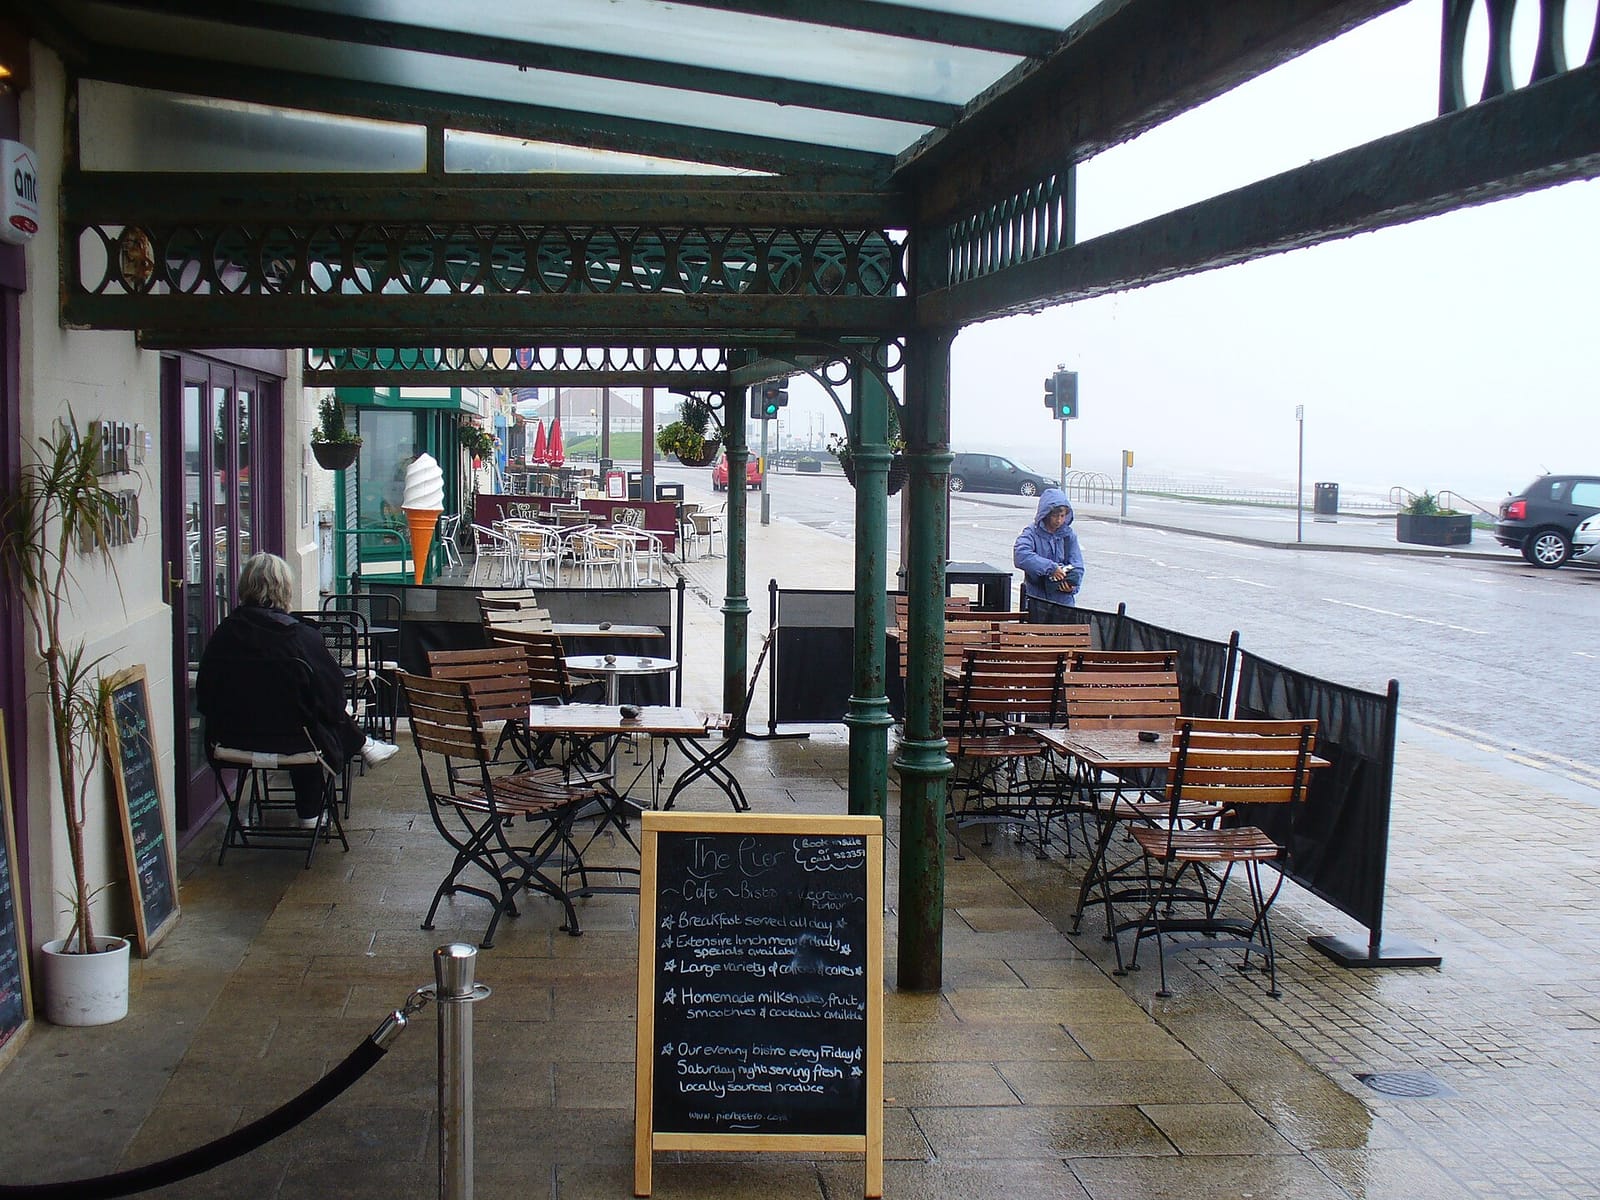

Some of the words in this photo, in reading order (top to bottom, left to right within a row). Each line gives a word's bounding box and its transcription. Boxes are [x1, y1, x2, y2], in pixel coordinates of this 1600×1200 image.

[685, 836, 730, 871] The
[801, 838, 828, 849] Book
[682, 879, 719, 905] Cafe
[678, 911, 743, 929] Breakfast
[744, 915, 787, 928] served
[789, 915, 808, 928] all
[808, 917, 833, 933] day
[676, 934, 733, 947] Extensive
[735, 934, 767, 946] lunch
[768, 936, 798, 947] menu
[693, 947, 745, 959] specials
[680, 959, 722, 978] Large
[723, 960, 766, 978] variety
[768, 961, 778, 977] of
[681, 986, 755, 1005] Homemade
[827, 992, 858, 1009] fruit
[686, 1007, 756, 1020] smoothies
[769, 1008, 821, 1019] cocktails
[678, 1042, 703, 1057] Our
[704, 1045, 748, 1063] evening
[752, 1043, 787, 1057] bistro
[789, 1048, 820, 1063] every
[820, 1045, 855, 1064] Friday
[677, 1059, 736, 1083] Saturday
[768, 1065, 811, 1084] serving
[812, 1063, 843, 1081] fresh
[727, 1081, 773, 1094] sourced
